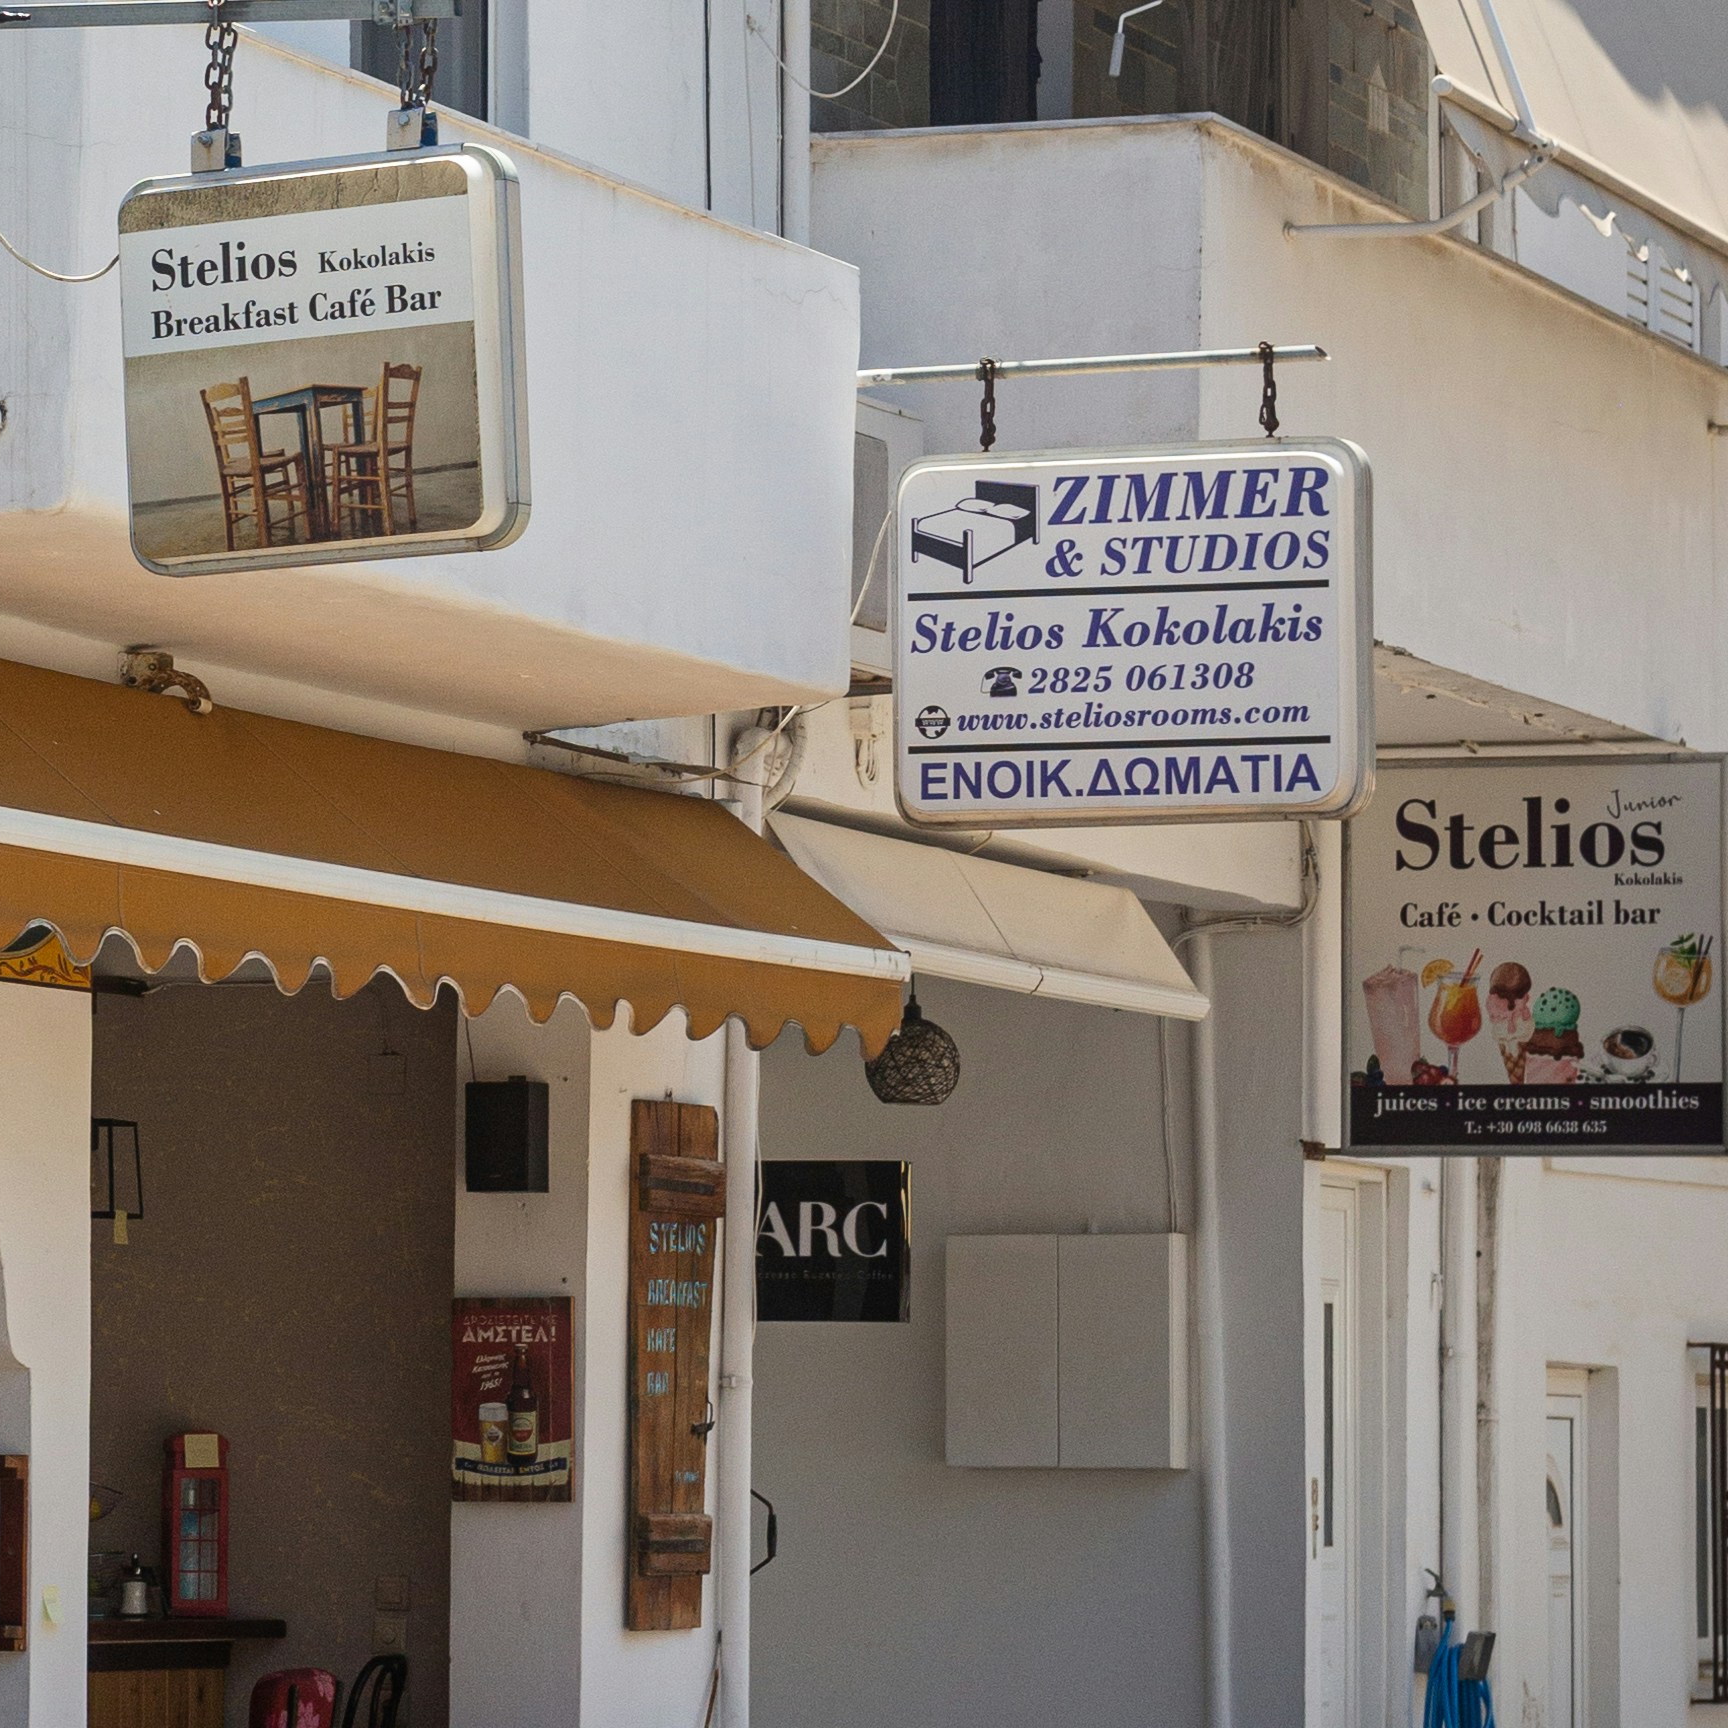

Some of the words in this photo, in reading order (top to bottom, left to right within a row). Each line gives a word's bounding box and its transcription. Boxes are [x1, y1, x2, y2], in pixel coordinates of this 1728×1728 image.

[151, 242, 298, 291] Stelios
[317, 242, 436, 274] Kokolakis
[151, 300, 299, 339] Breakfast
[308, 288, 376, 322] Café
[385, 284, 442, 315] Bar
[1047, 466, 1330, 526] ZIMMER
[1045, 538, 1084, 578] &
[1099, 530, 1330, 576] STUDIOS
[910, 611, 1064, 654] Stelios
[1081, 602, 1323, 648] Kokolakis
[1027, 665, 1112, 695] 2825
[1126, 662, 1255, 692] 061308
[956, 700, 1310, 733] www.steliosrooms.com
[920, 753, 1322, 801] ΕΝΟΙΚ.ΔΩΜΑΤΙΑ
[1607, 789, 1682, 819] Junior
[1395, 796, 1665, 871] Stelios
[1614, 872, 1683, 886] Kokolakis
[1399, 902, 1462, 928] Café
[1487, 900, 1604, 926] Cocktail
[1614, 900, 1661, 926] bar
[1374, 1091, 1438, 1118] juices
[1457, 1091, 1487, 1111] ice
[1493, 1094, 1570, 1111] creams
[1589, 1090, 1700, 1110] smoothies
[1486, 1121, 1513, 1134] +30
[1517, 1120, 1542, 1134] 698
[1545, 1120, 1579, 1134] 6638
[1582, 1120, 1607, 1134] 635
[649, 1222, 706, 1256] STELIOS
[462, 1325, 557, 1343] ΑΜΣΤΕΛ!
